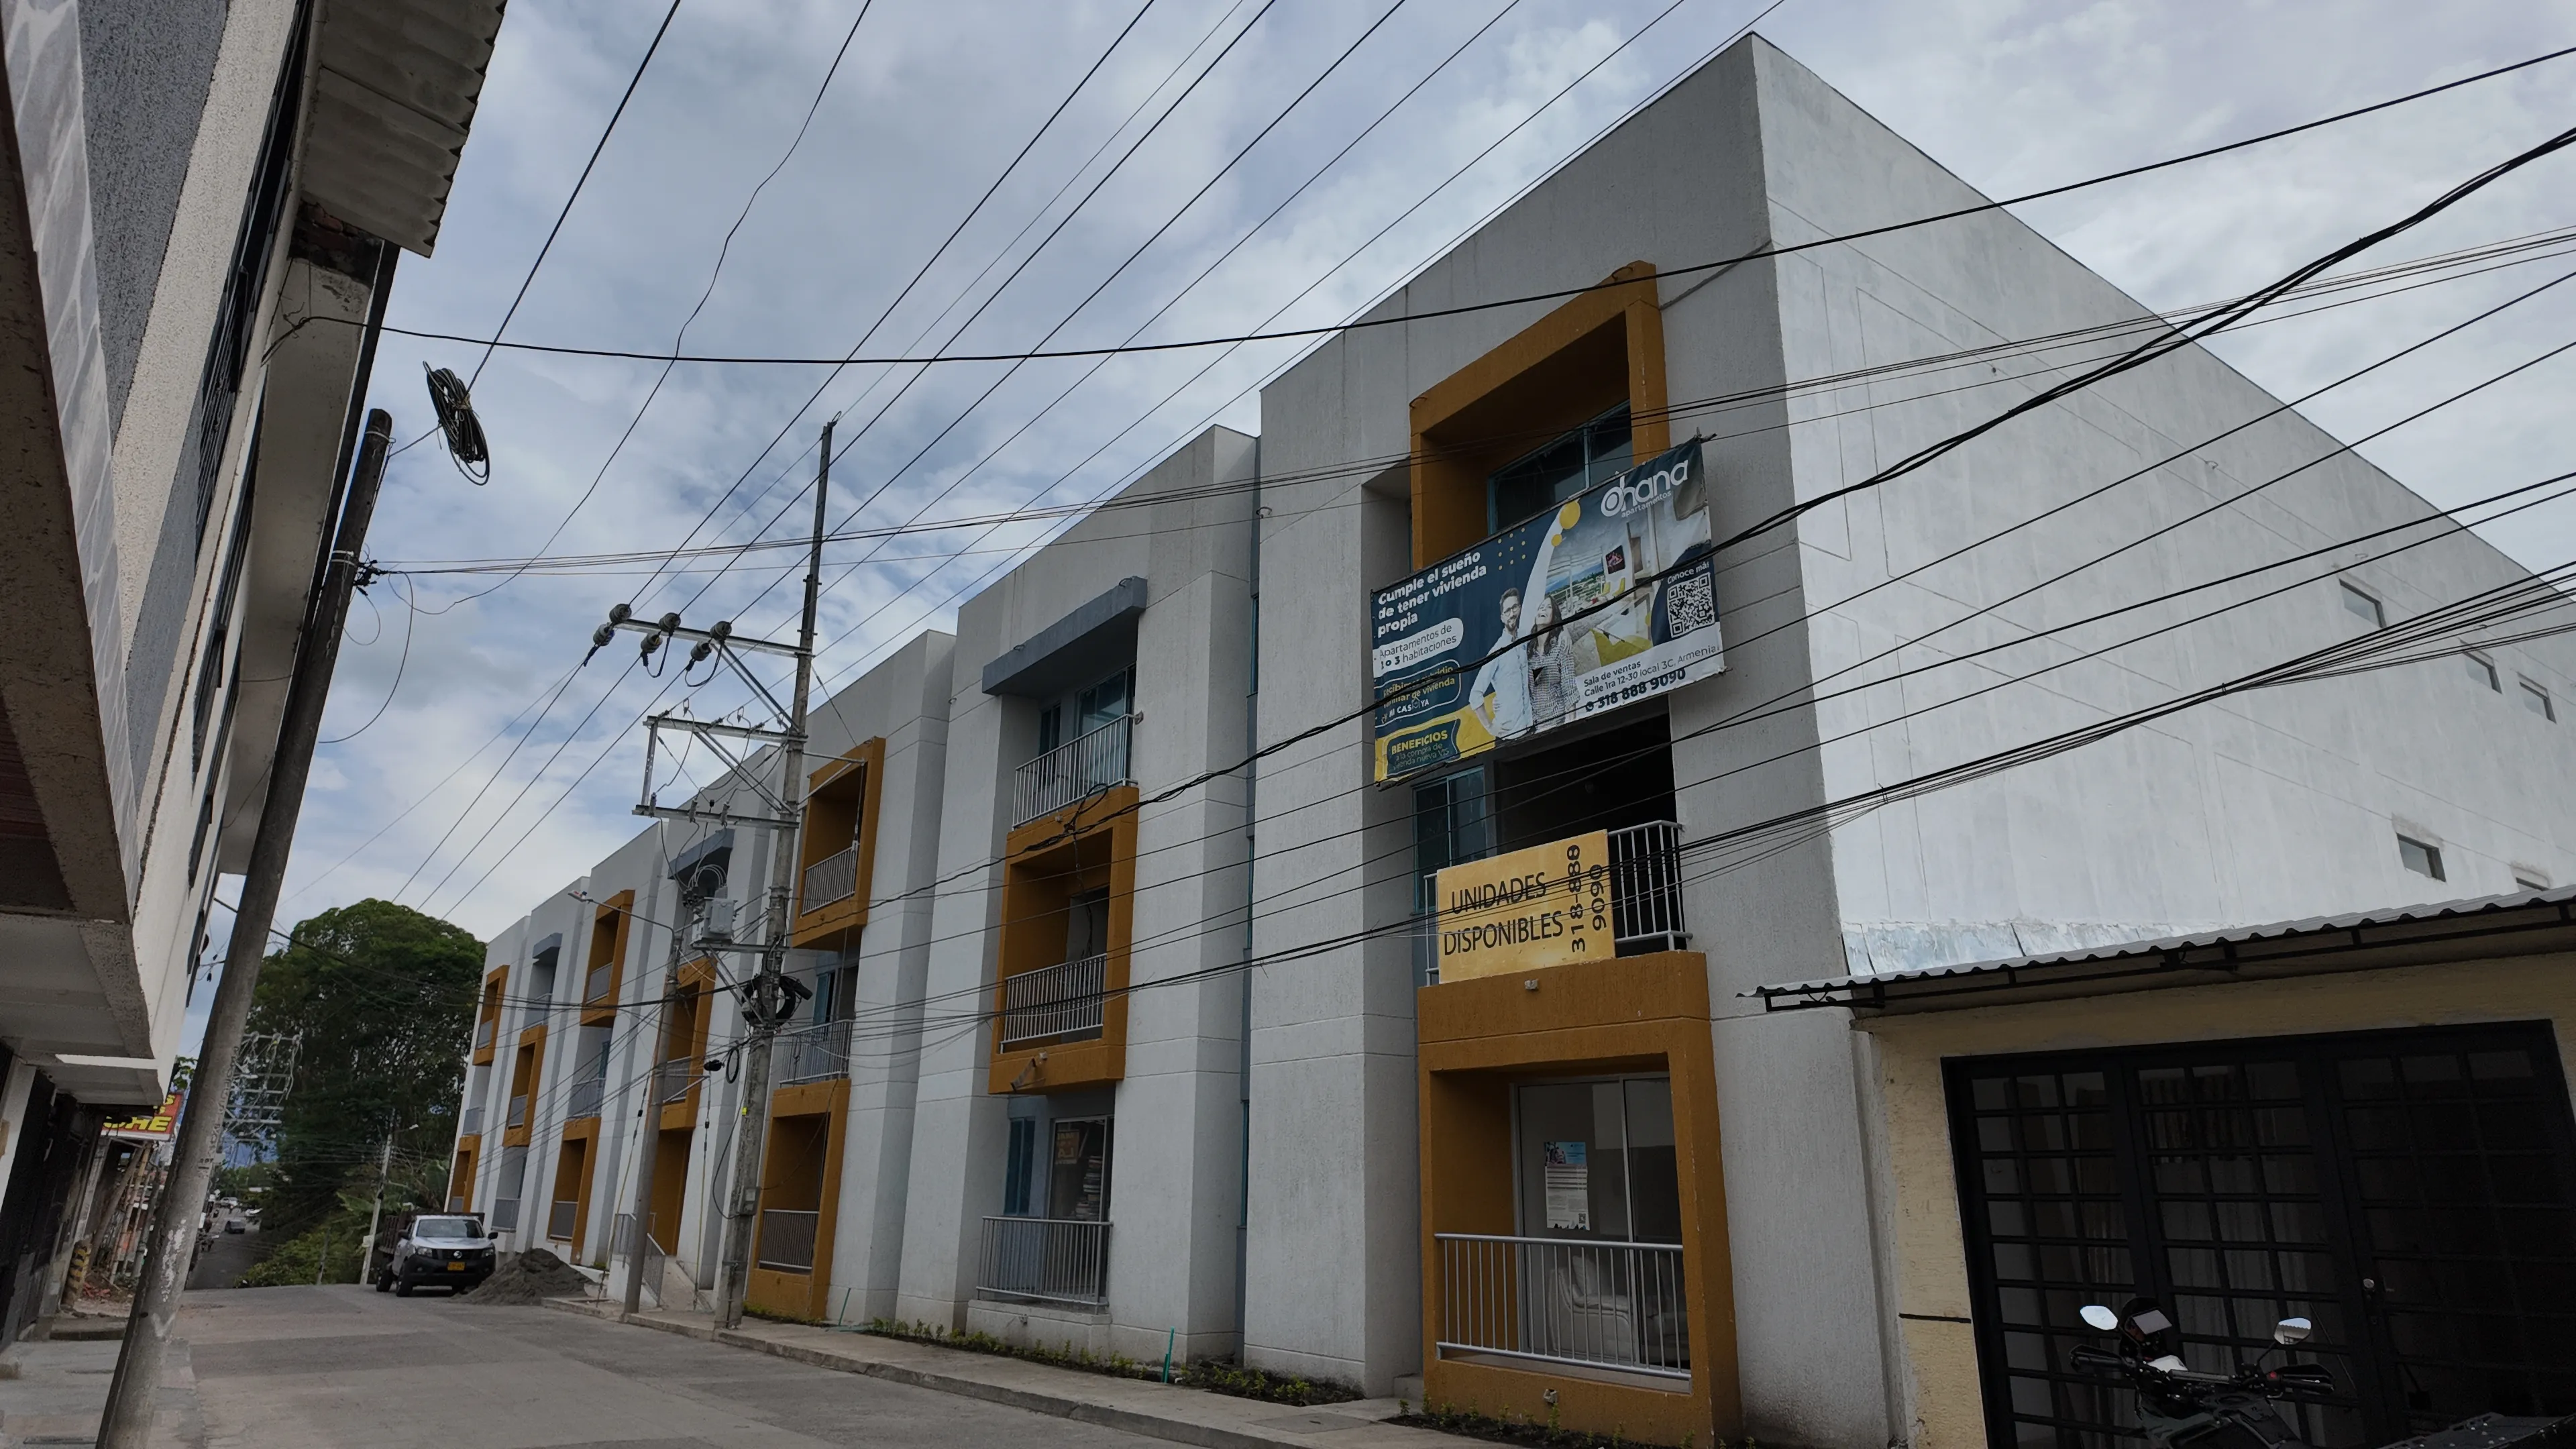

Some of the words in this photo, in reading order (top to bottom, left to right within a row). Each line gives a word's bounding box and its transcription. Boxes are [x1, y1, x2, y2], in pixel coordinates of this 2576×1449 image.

[1621, 490, 1672, 519] apartamentos
[1378, 578, 1424, 605] Cumple
[1427, 568, 1438, 584] el
[1442, 551, 1481, 578] sueño
[1667, 568, 1695, 584] Conoce
[1379, 606, 1394, 620] de
[1397, 591, 1430, 613] tener
[1432, 566, 1487, 598] vivienda
[1378, 611, 1418, 639] propia
[1440, 624, 1452, 635] de
[1395, 655, 1400, 665] 3
[1403, 635, 1457, 663] habitaciones
[1422, 678, 1455, 695] vivienda
[1583, 675, 1599, 688] Sala
[1601, 670, 1611, 681] de
[1612, 661, 1642, 676] ventas
[1584, 685, 1604, 697] Calle
[1605, 680, 1616, 690] 1ra
[1617, 672, 1638, 685] 12-30
[1640, 664, 1660, 678] local
[1597, 692, 1619, 709] 318
[1621, 681, 1647, 700] 888
[1650, 667, 1686, 690] 9090
[1420, 698, 1430, 707] YA
[1391, 730, 1448, 755] BENEFICIOS
[1406, 745, 1432, 759] compra
[1416, 752, 1437, 764] nueva
[1452, 871, 1547, 914] UNIDADES
[1589, 864, 1607, 931] 9090
[1444, 910, 1564, 956] DISPONIBLES
